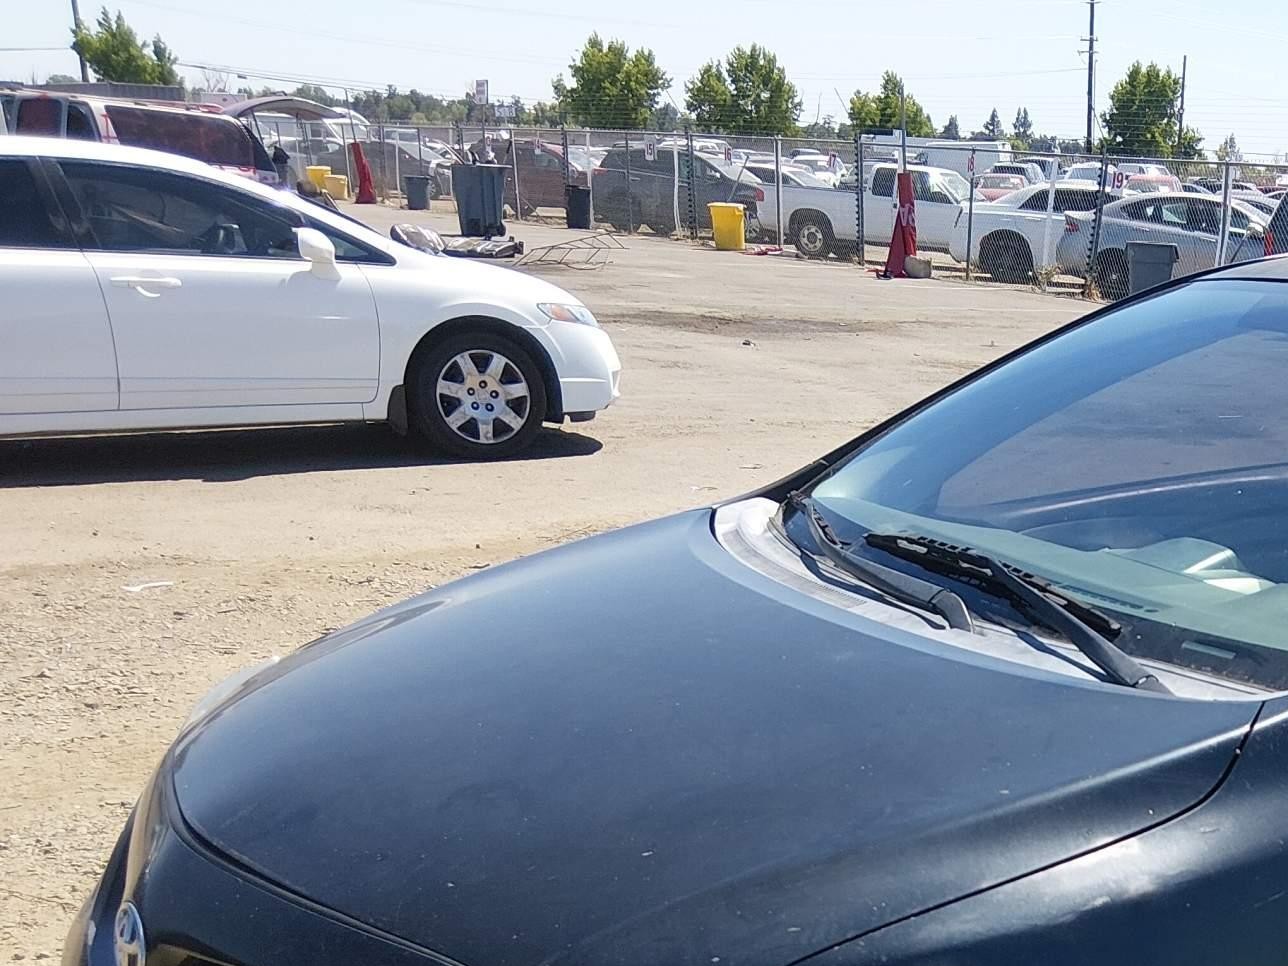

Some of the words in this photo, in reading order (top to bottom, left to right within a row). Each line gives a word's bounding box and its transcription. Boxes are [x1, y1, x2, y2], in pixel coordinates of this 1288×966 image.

[724, 146, 732, 161] 16
[967, 155, 975, 172] 18
[1112, 171, 1124, 189] 19
